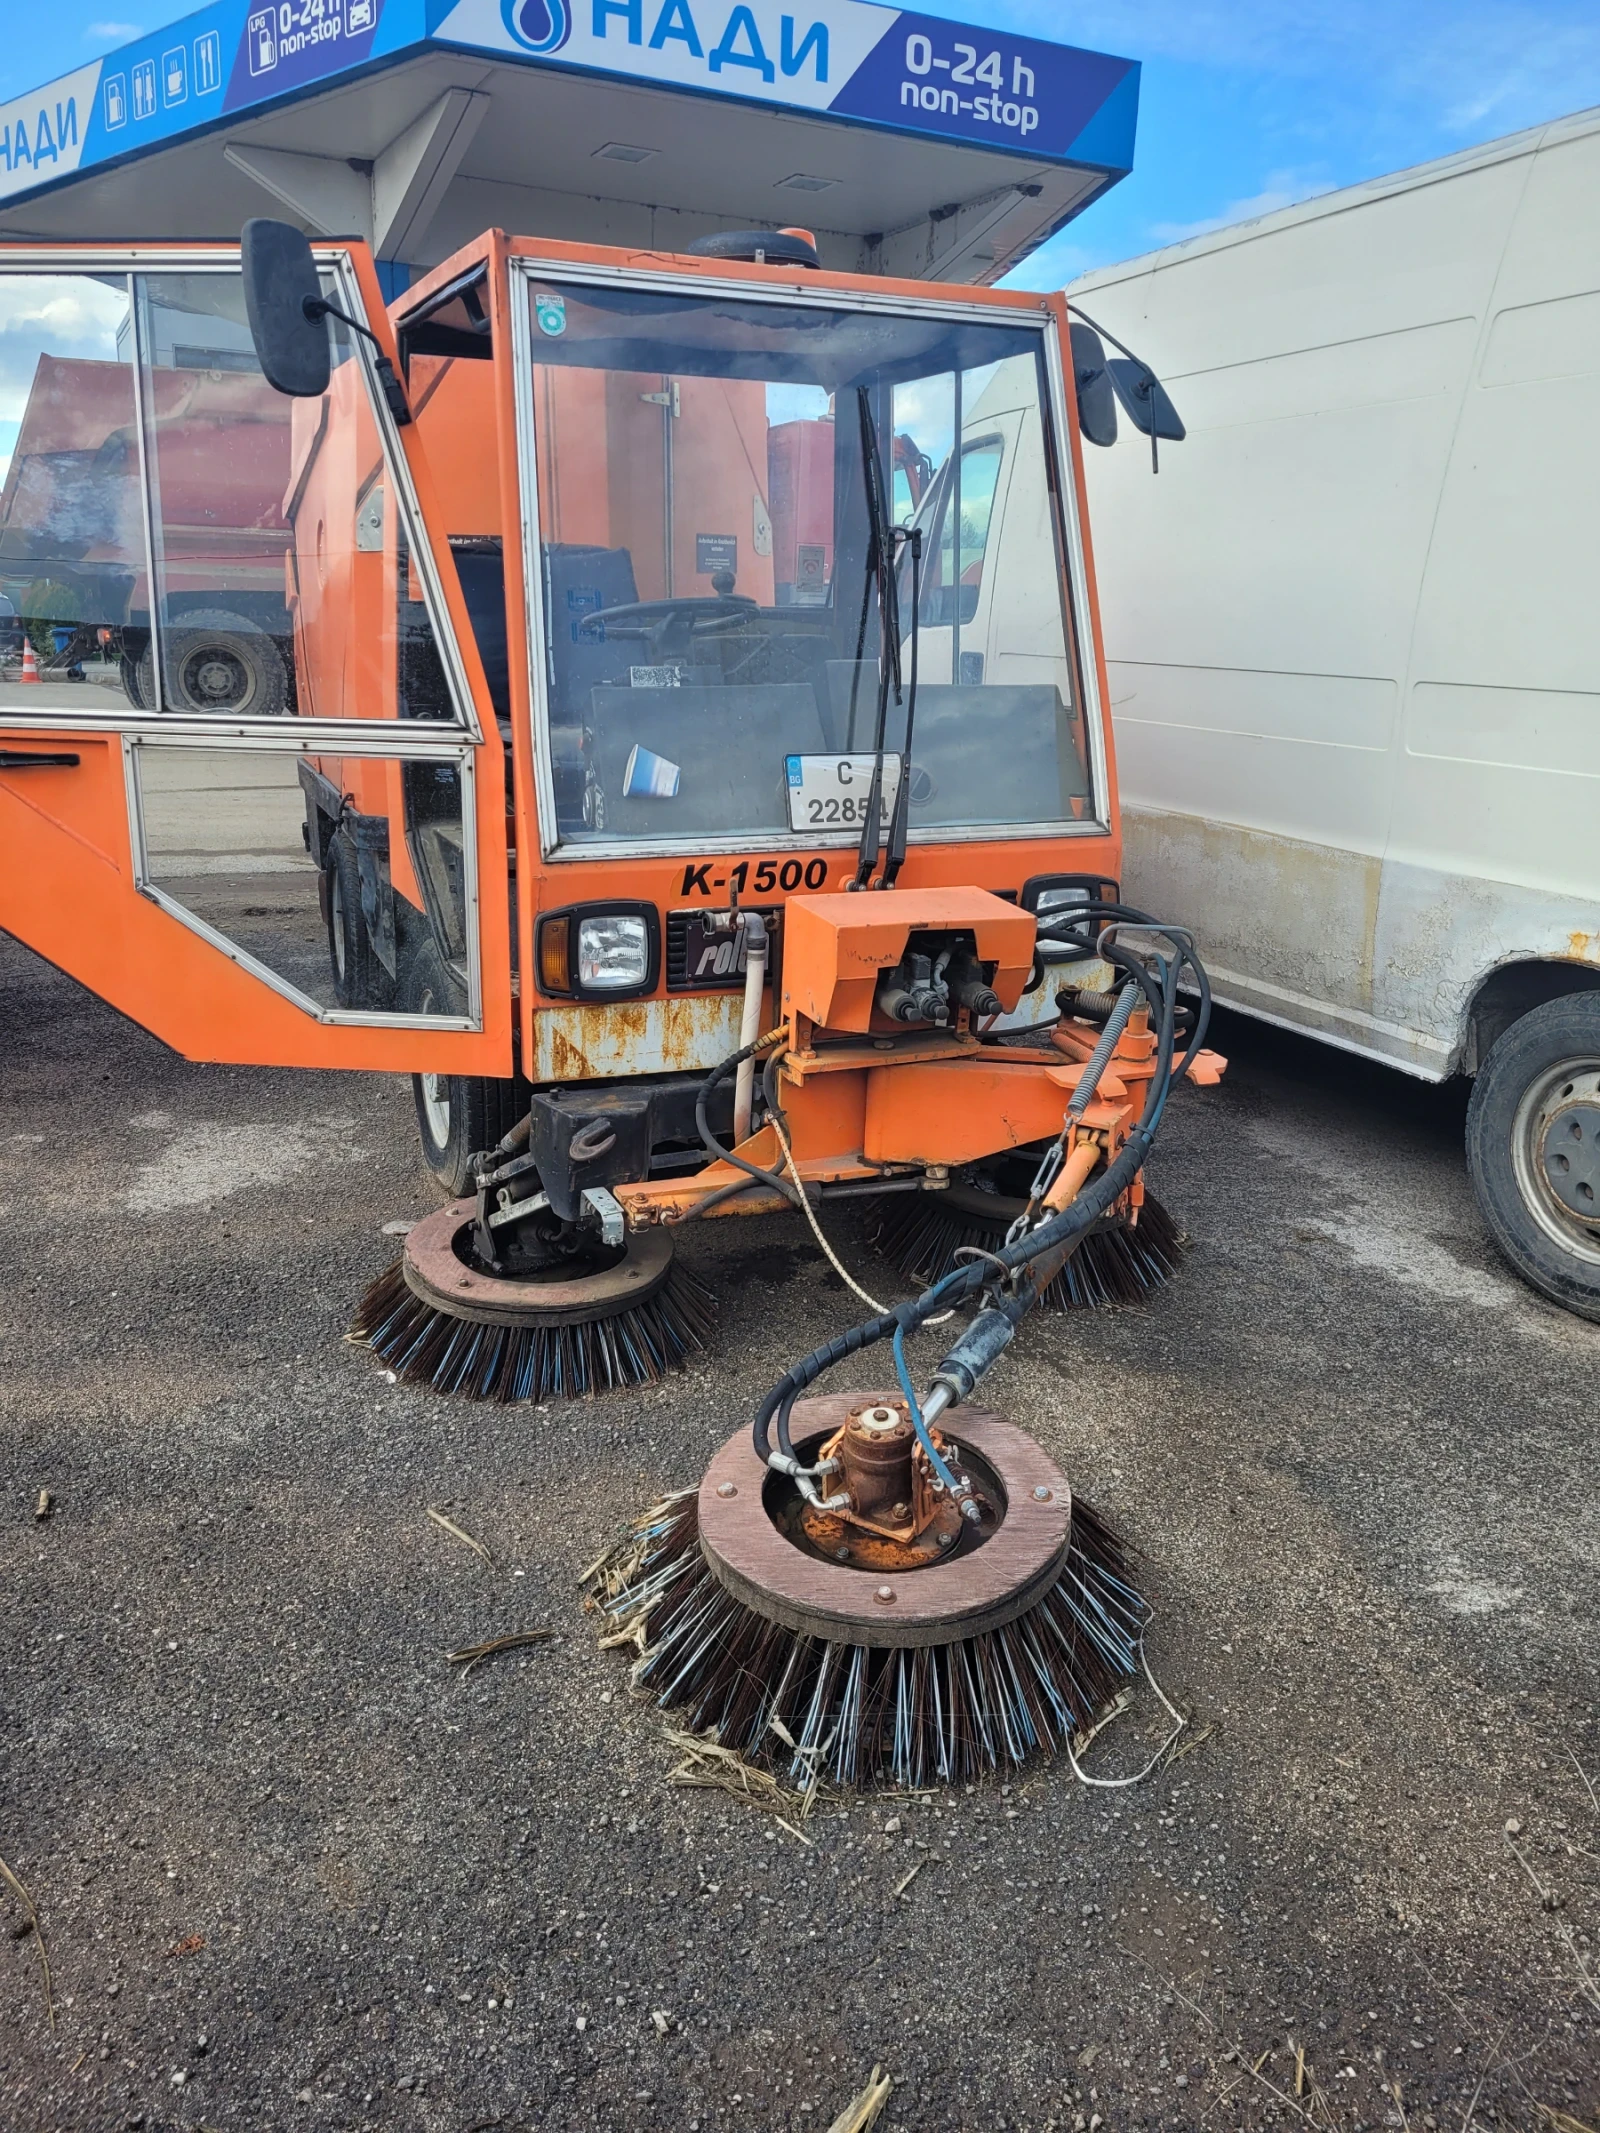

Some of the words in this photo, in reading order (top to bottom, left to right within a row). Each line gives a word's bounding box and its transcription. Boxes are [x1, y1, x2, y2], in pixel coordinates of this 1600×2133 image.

[250, 16, 266, 32] LPG
[280, 16, 341, 57] non-stop
[592, 0, 829, 84] НАДИ
[906, 34, 1004, 90] 0-24
[1012, 56, 1035, 97] h
[901, 81, 1039, 136] non-stop
[789, 775, 801, 784] BG
[680, 858, 828, 896] K-1500
